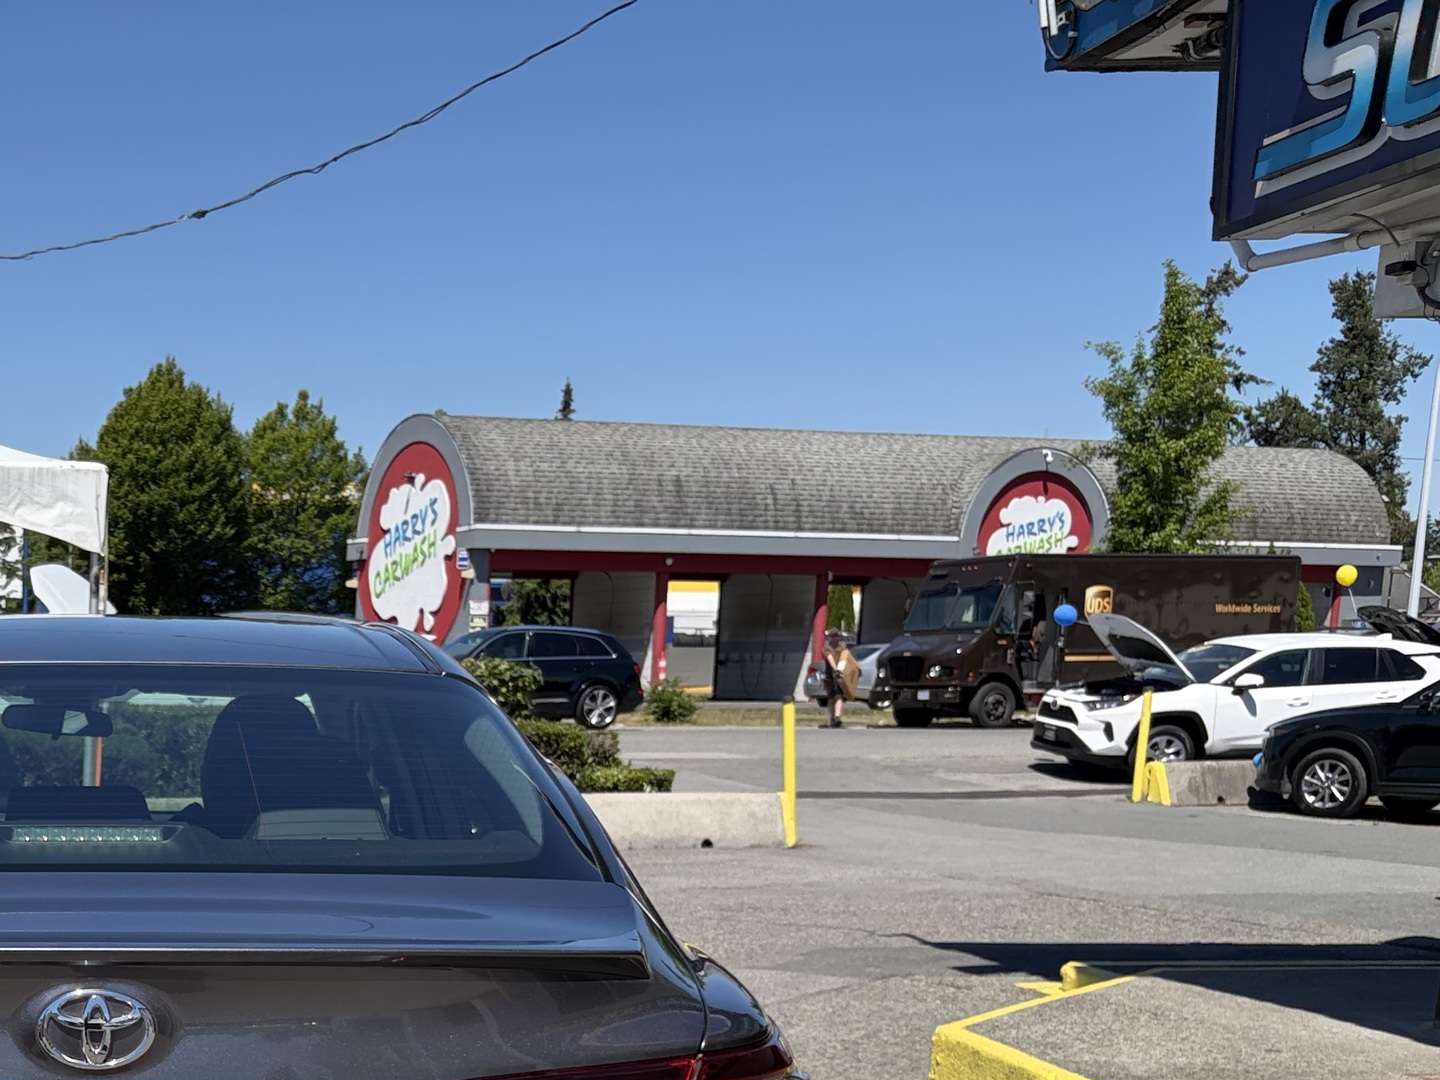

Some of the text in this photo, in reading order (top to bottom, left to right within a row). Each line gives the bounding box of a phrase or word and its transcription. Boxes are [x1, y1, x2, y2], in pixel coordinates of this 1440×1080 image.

[383, 497, 439, 559] HARRY'S
[1006, 510, 1065, 543] HARRY'S
[373, 528, 437, 599] CARWASH
[1215, 603, 1281, 613] Worldwide Services
